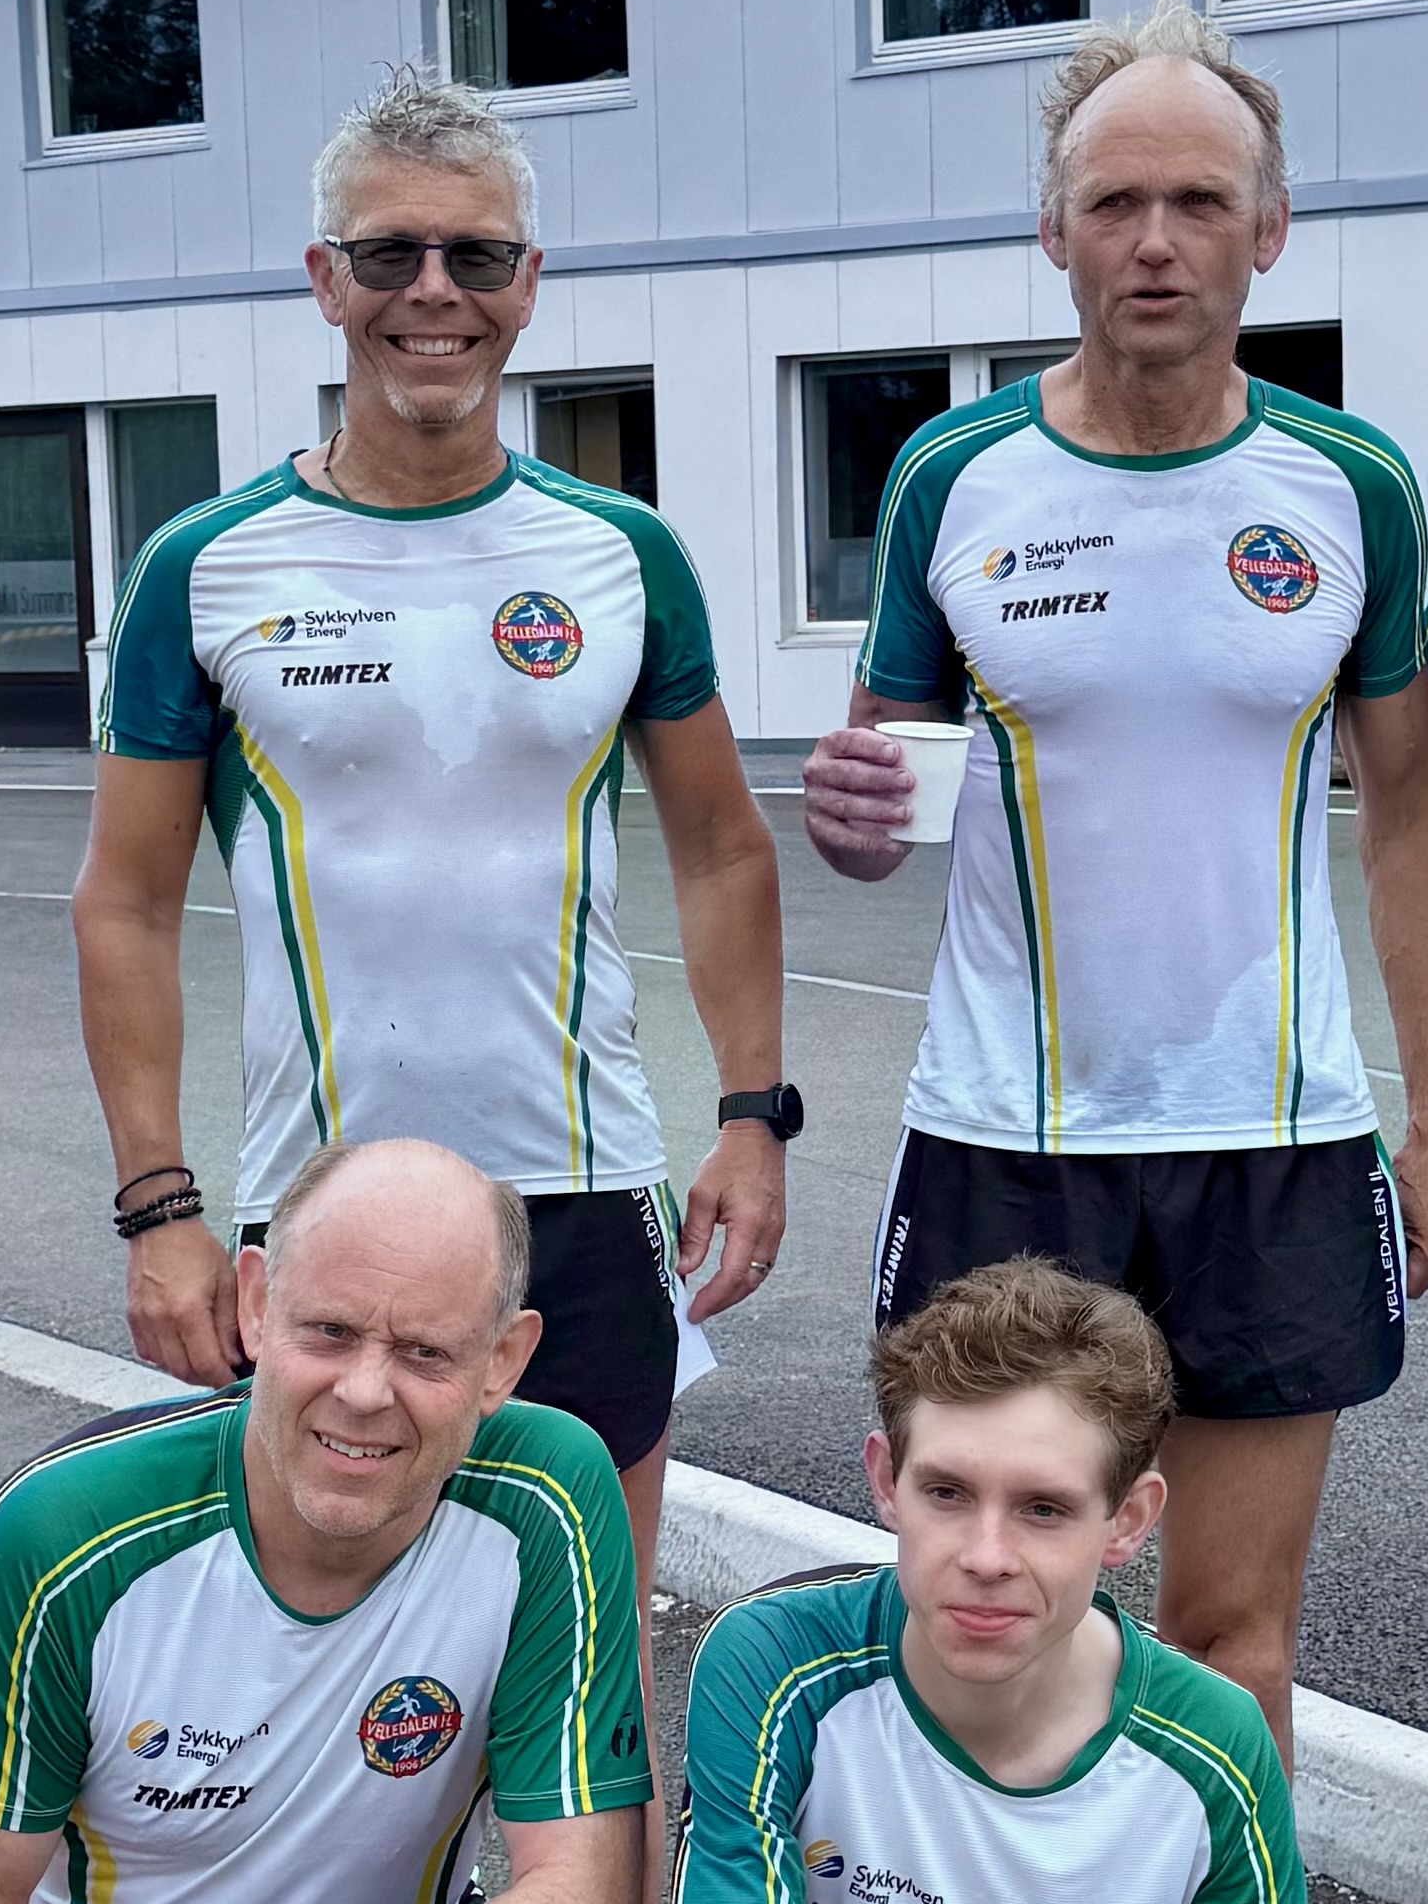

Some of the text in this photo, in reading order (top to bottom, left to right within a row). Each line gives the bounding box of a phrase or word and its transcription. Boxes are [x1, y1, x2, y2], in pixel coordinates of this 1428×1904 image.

[1025, 535, 1114, 560] Sykkylven
[1026, 555, 1065, 571] Energi
[304, 609, 396, 628] Sykkylven
[1001, 591, 1111, 623] TRIMTEX
[306, 624, 347, 638] Energi
[281, 662, 393, 687] TRIMTEX
[1369, 1163, 1402, 1322] VELLEDALEN IL
[881, 1215, 911, 1312] TRIMTEX
[177, 1745, 221, 1767] Energi
[394, 1760, 420, 1773] 1906
[133, 1784, 255, 1812] TRIMTEX
